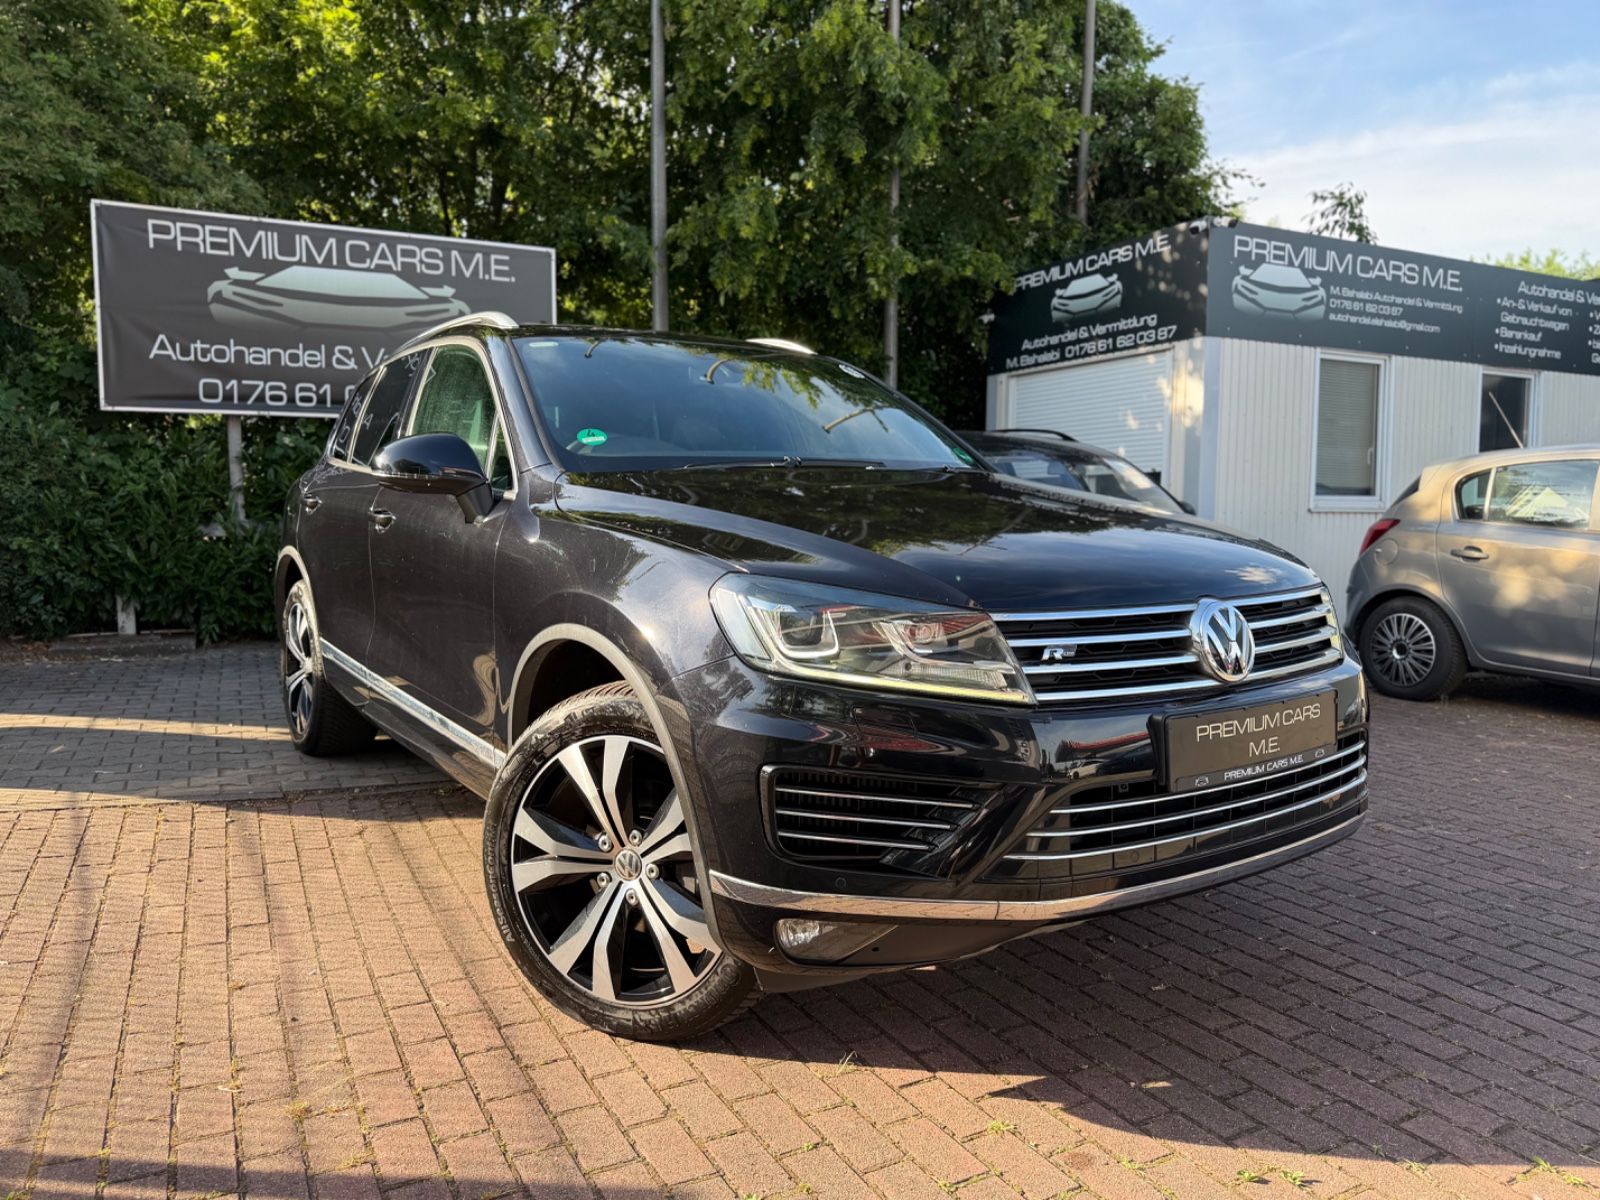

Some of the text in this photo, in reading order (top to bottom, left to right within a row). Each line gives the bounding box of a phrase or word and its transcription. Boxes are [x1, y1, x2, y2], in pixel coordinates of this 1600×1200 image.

[147, 218, 516, 283] PREMIUM CARS M.E.
[1233, 234, 1463, 292] PREMIUM CARS M.E.
[1014, 258, 1084, 290] PREMIUM
[1085, 245, 1133, 272] CARS
[1329, 298, 1352, 310] 0176
[1374, 291, 1415, 306] Autohandel
[1517, 280, 1576, 302] Autohandel
[1576, 290, 1585, 304] &
[1526, 300, 1558, 314] Verkauf
[1557, 306, 1573, 317] von
[1020, 314, 1158, 351] Autohandel & Vermittlung
[1064, 339, 1097, 359] 0176
[1097, 336, 1114, 352] 61
[1116, 334, 1137, 348] 62
[1136, 329, 1156, 346] 03
[1156, 325, 1178, 340] 87
[149, 333, 326, 370] Autohandel
[332, 344, 358, 370] &
[198, 378, 289, 407] 0176
[295, 382, 332, 408] 61
[1196, 703, 1321, 743] PREMIUM CARS
[1248, 736, 1281, 758] M.E.
[1224, 763, 1265, 781] PREMIUM
[1266, 758, 1289, 772] CARS
